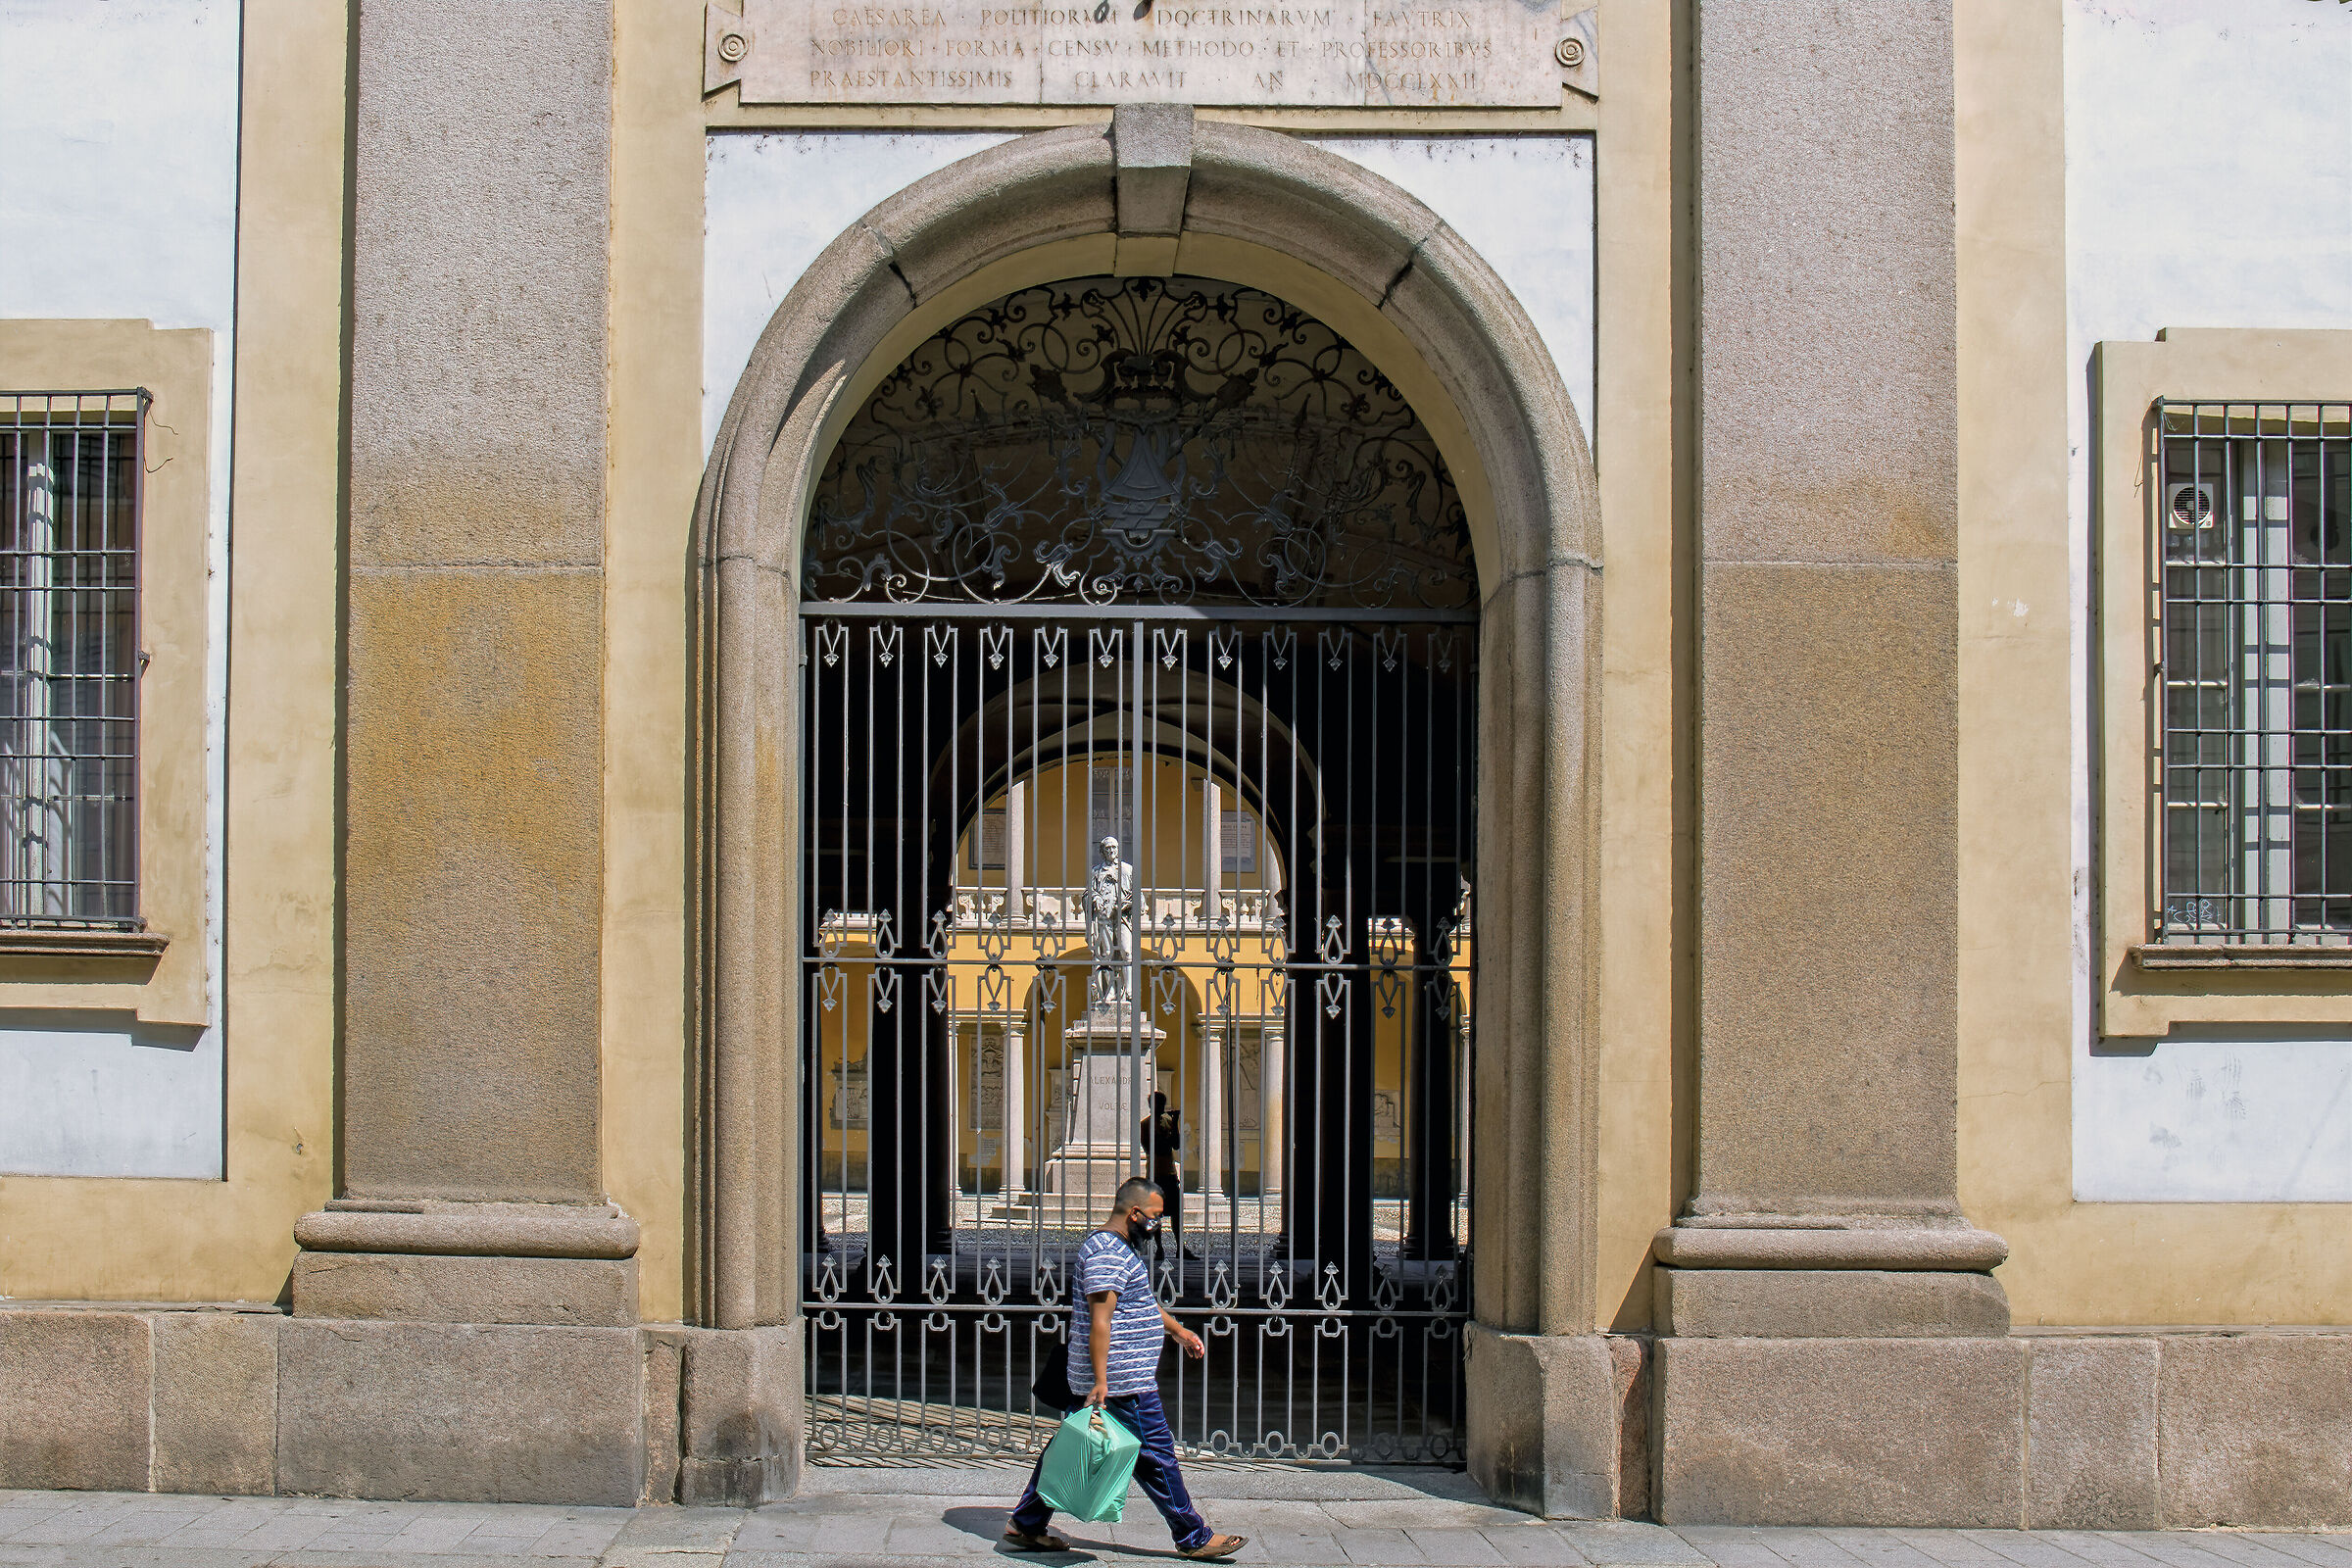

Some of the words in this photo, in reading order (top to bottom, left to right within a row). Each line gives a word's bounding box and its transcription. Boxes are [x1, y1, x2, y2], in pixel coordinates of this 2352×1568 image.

[832, 8, 947, 26] CAESAREA
[1157, 9, 1331, 26] DOCTRINARVM
[1373, 10, 1473, 27] FAVTRIX
[809, 39, 924, 57] NOBILIORI
[946, 40, 1025, 58] FORMA
[1049, 40, 1119, 57] CENSV
[1143, 40, 1254, 57] METHODO
[1277, 40, 1299, 57] ET
[1322, 40, 1493, 59] PROFESSORIBVS
[809, 70, 1013, 88] PRAESTANTISSIMIS
[1074, 71, 1188, 89] CLARAVIT
